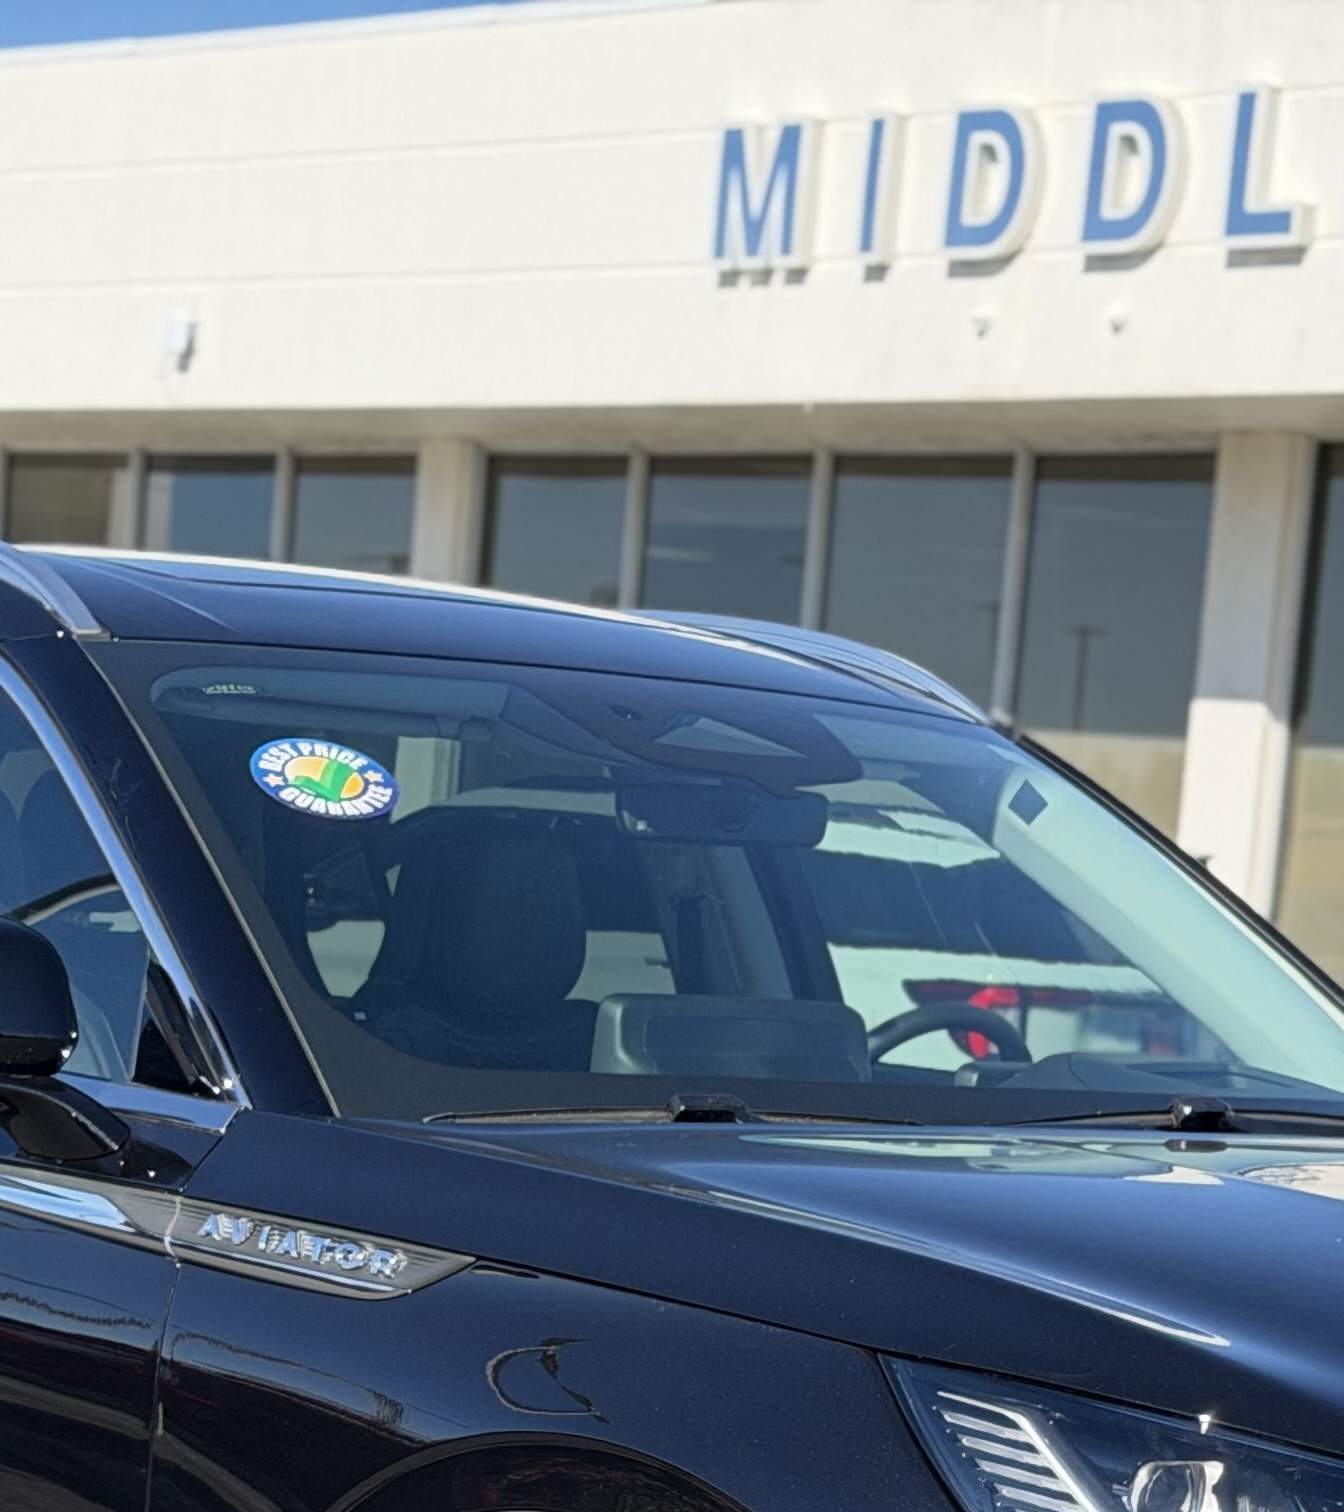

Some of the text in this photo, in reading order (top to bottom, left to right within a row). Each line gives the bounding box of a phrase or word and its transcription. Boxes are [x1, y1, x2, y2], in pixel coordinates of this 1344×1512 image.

[259, 742, 368, 772] BEST PRICE
[279, 784, 394, 816] GUARANTEE
[198, 1213, 408, 1279] AVIATOR
